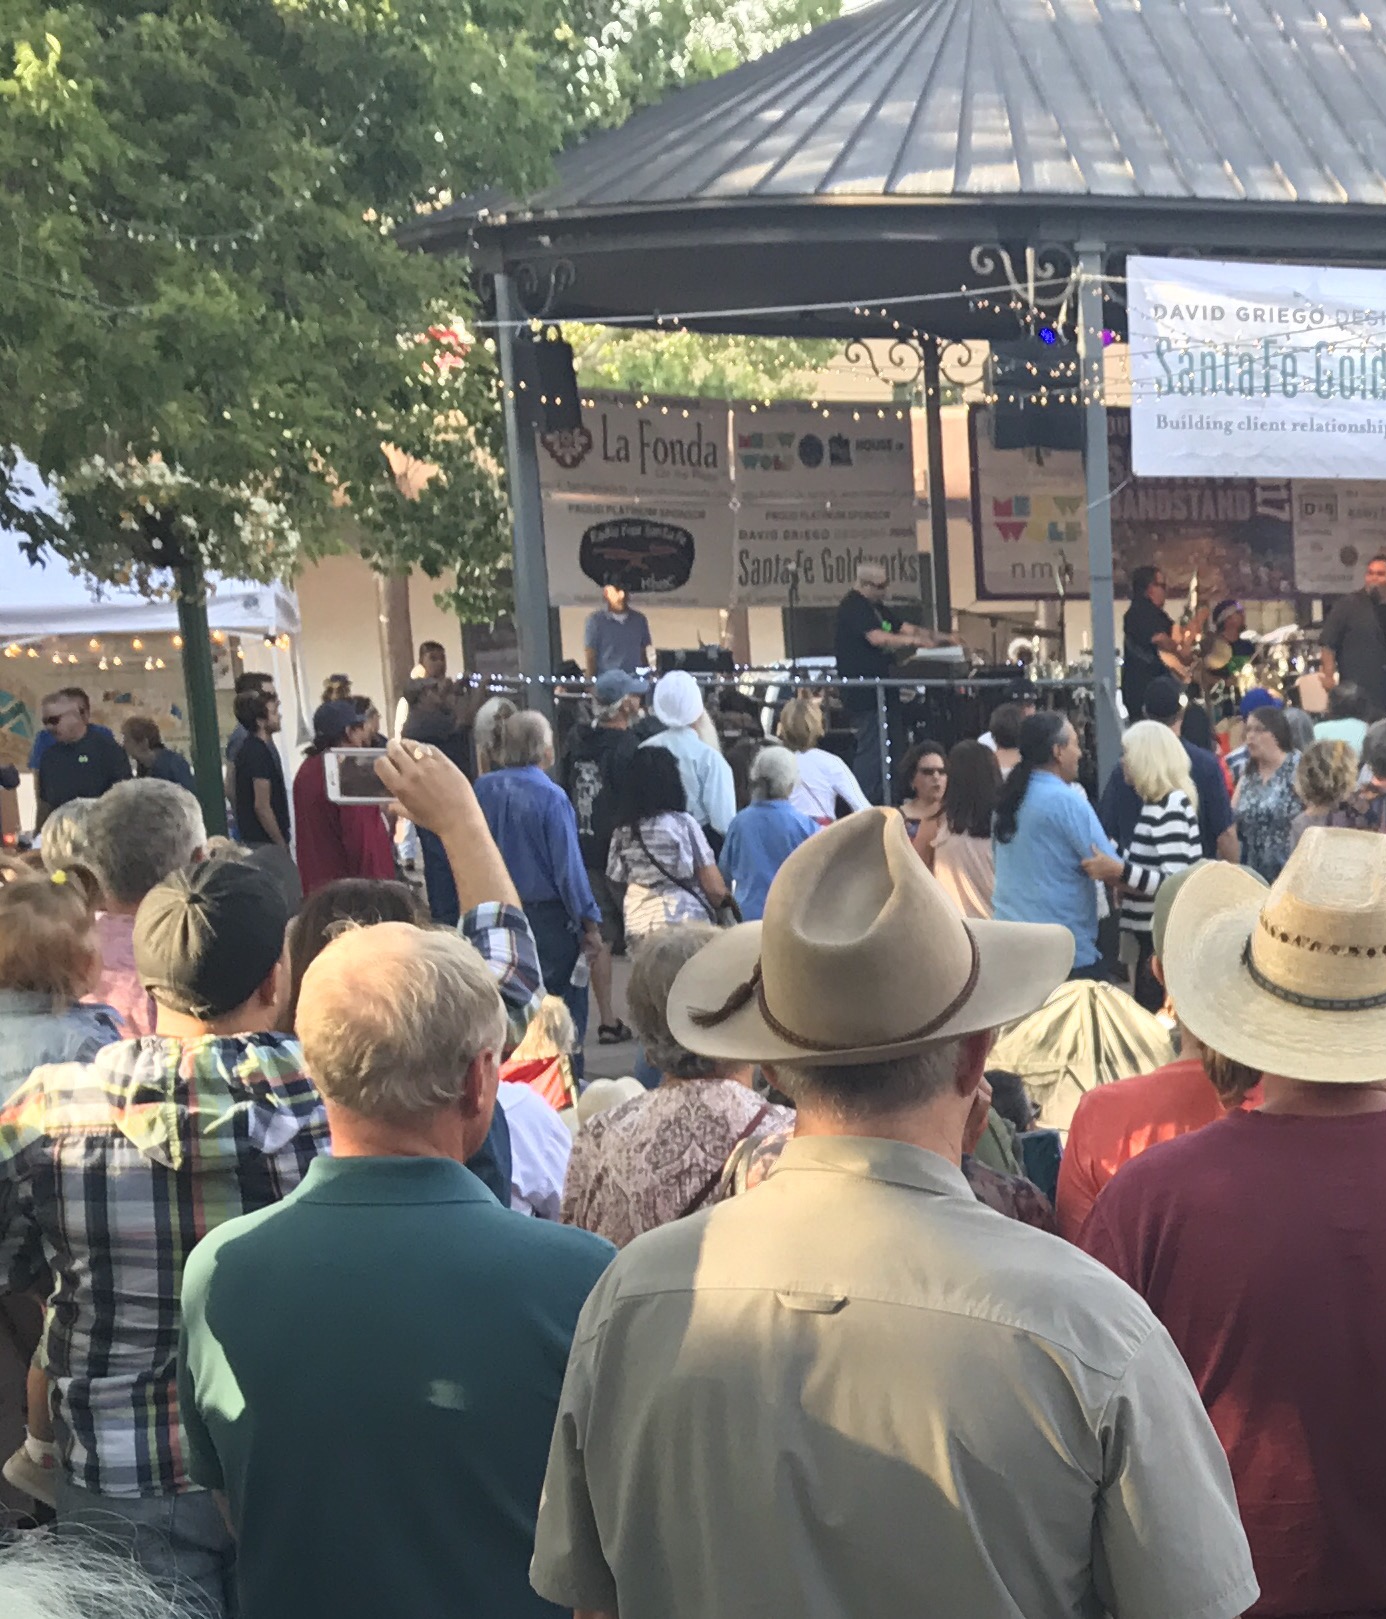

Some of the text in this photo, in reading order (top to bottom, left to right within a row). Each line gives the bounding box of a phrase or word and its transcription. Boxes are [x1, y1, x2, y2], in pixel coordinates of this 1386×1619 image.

[1153, 304, 1225, 321] DAVID
[1236, 306, 1325, 324] GRIEGO
[1156, 414, 1233, 435] Building
[1237, 416, 1287, 432] client
[602, 413, 718, 475] La Fonda
[820, 546, 918, 585] Goldorks
